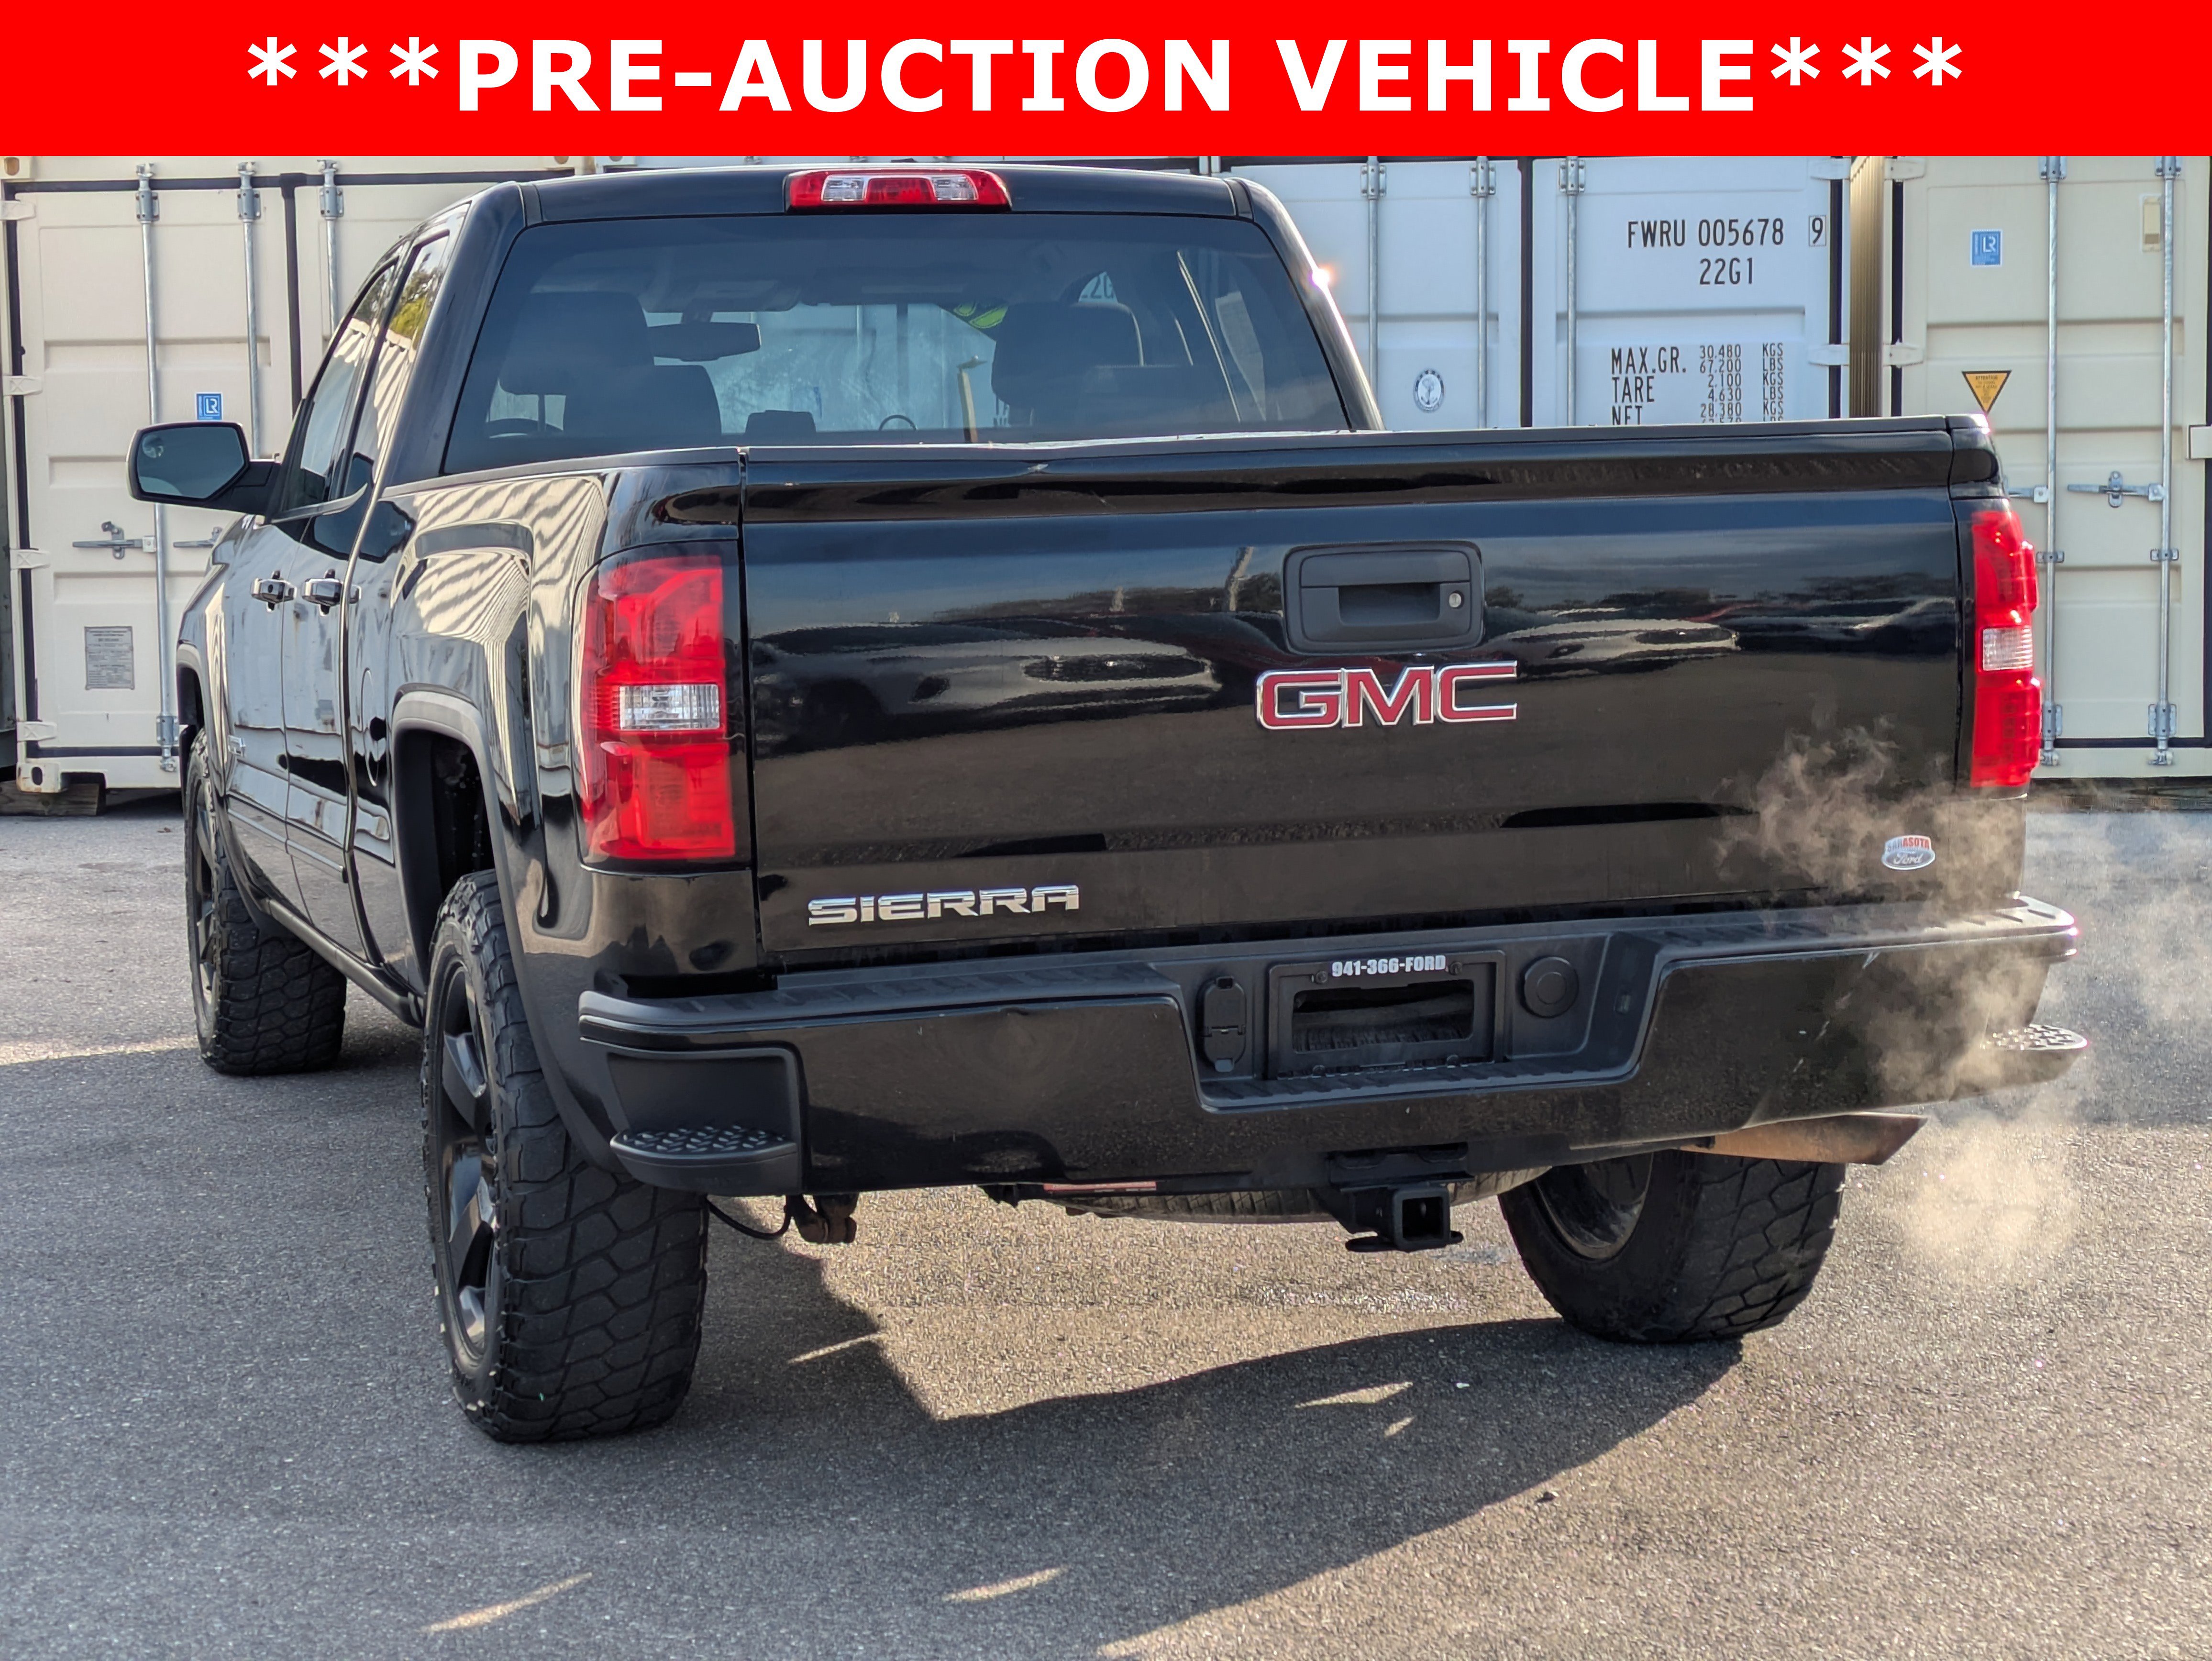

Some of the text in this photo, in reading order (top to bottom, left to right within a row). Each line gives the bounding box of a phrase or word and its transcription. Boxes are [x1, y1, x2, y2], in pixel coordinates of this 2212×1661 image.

[1627, 217, 1823, 248] FWRU 005678 9
[1699, 257, 1753, 285] 22G1
[1611, 342, 1783, 374] MAX.GR. 30.480 KGS
[1700, 357, 1783, 373] 67.200 LBS
[1612, 371, 1783, 403] TARE 2.100 KGS
[1708, 386, 1783, 402] 4.630 LBS
[1701, 402, 1742, 418] 28.380
[1763, 400, 1784, 415] KGS
[1255, 661, 1517, 730] GMC
[1893, 853, 1924, 864] Ford
[808, 885, 1079, 926] SIERRA
[1332, 955, 1446, 977] 941-366-FORD
